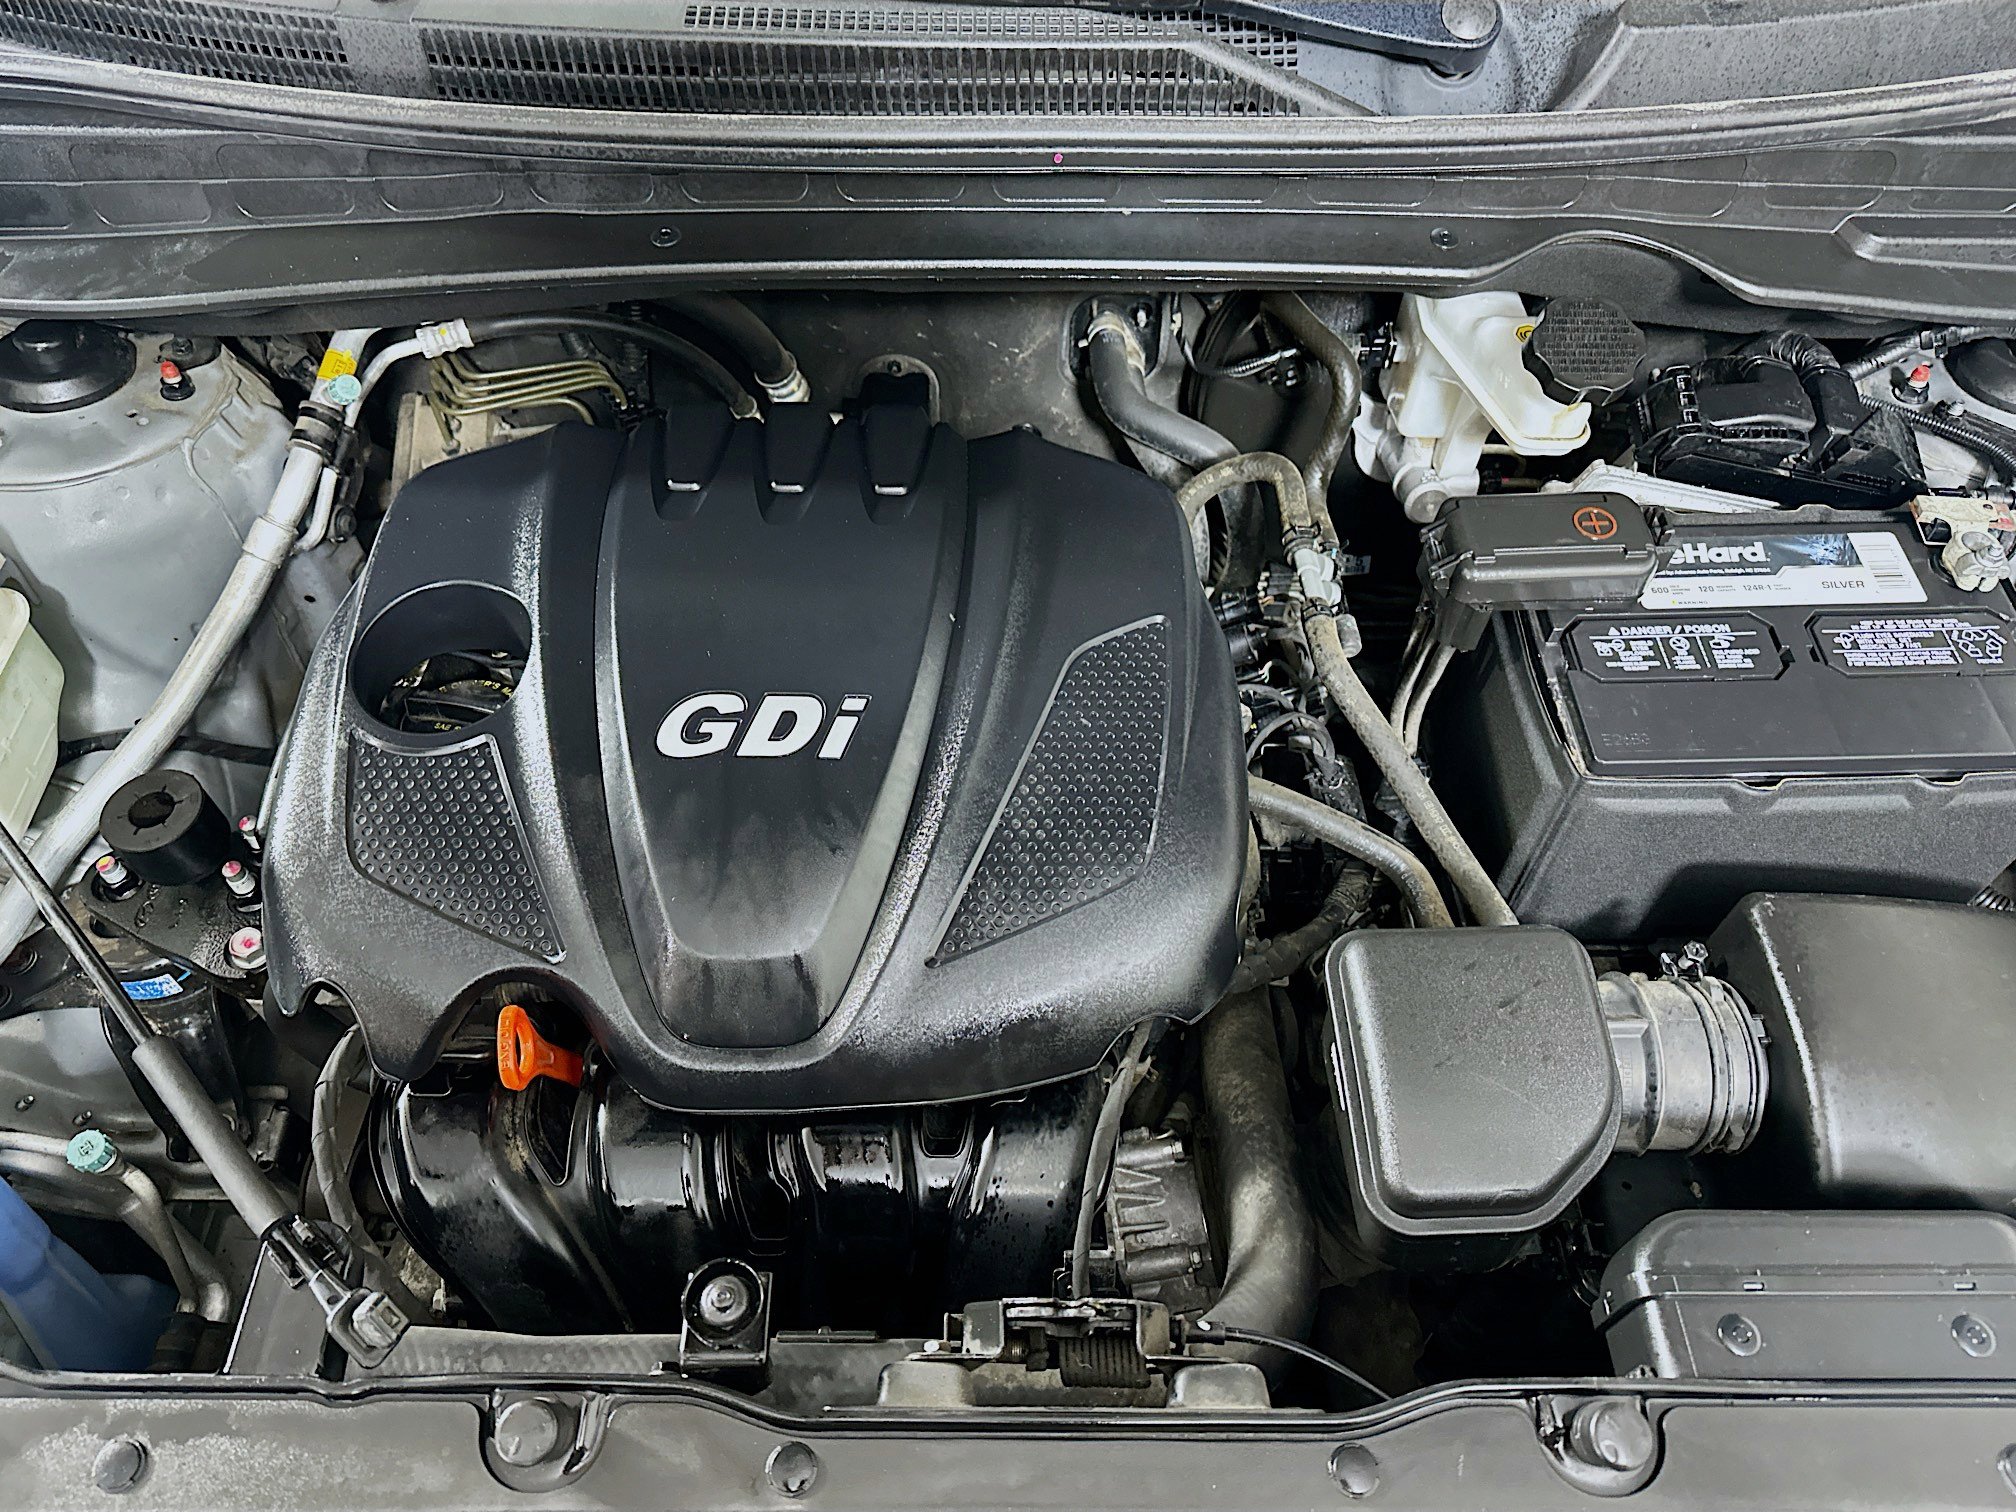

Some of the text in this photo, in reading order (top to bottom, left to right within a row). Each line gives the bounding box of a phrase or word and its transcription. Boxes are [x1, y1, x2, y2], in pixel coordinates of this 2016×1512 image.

[1698, 585, 1715, 593] 120
[1821, 580, 1865, 589] SILVER
[1620, 625, 1672, 635] DANGER
[1683, 624, 1731, 634] POISON
[433, 722, 452, 731] SAE
[655, 690, 871, 760] GDi
[499, 1042, 510, 1069] ENG
